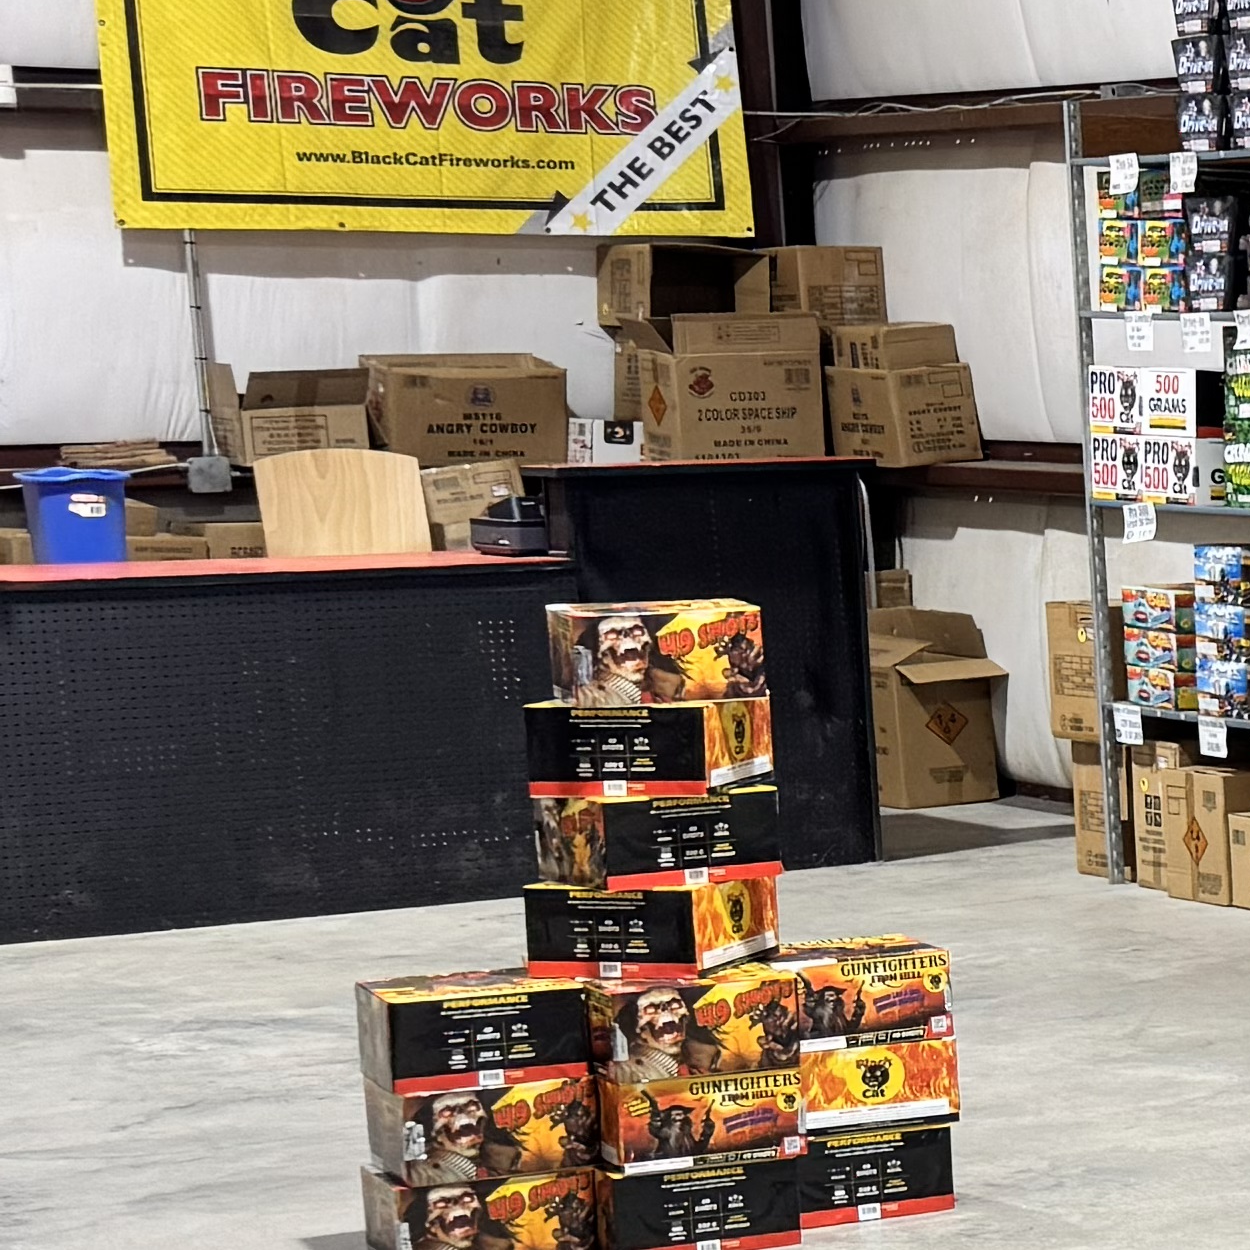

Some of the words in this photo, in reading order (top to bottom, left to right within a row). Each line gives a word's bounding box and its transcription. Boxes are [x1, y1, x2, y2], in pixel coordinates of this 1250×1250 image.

[197, 67, 660, 136] FIREWORKS
[296, 147, 576, 172] www.BlackCatFireworks.com
[589, 152, 656, 216] THE
[646, 89, 718, 162] BEST
[1090, 371, 1115, 395] PRO
[1155, 375, 1180, 395] 500
[704, 408, 740, 422] COLOR
[741, 407, 774, 421] SPACE
[775, 406, 798, 420] SHIP
[1091, 396, 1115, 420] 500
[1149, 397, 1187, 414] GRAMS
[426, 423, 473, 434] ANGRY
[480, 423, 537, 434] COWBOY
[713, 439, 742, 448] MADE
[757, 438, 789, 447] CHINA
[1093, 437, 1118, 462] PRO
[1144, 441, 1169, 464] PRO
[1093, 463, 1118, 487] 500
[1144, 466, 1169, 491] 500
[570, 707, 650, 719] PERFORMANCE
[568, 889, 645, 901] PERFORMANCE
[841, 953, 947, 977] GUNFIGHTERS
[442, 994, 529, 1009] PERFORMANCE
[689, 1071, 801, 1097] GUNFIGHTERS
[826, 1132, 902, 1148] PERFORMANCE
[663, 1166, 744, 1182] PERFORMANCE
